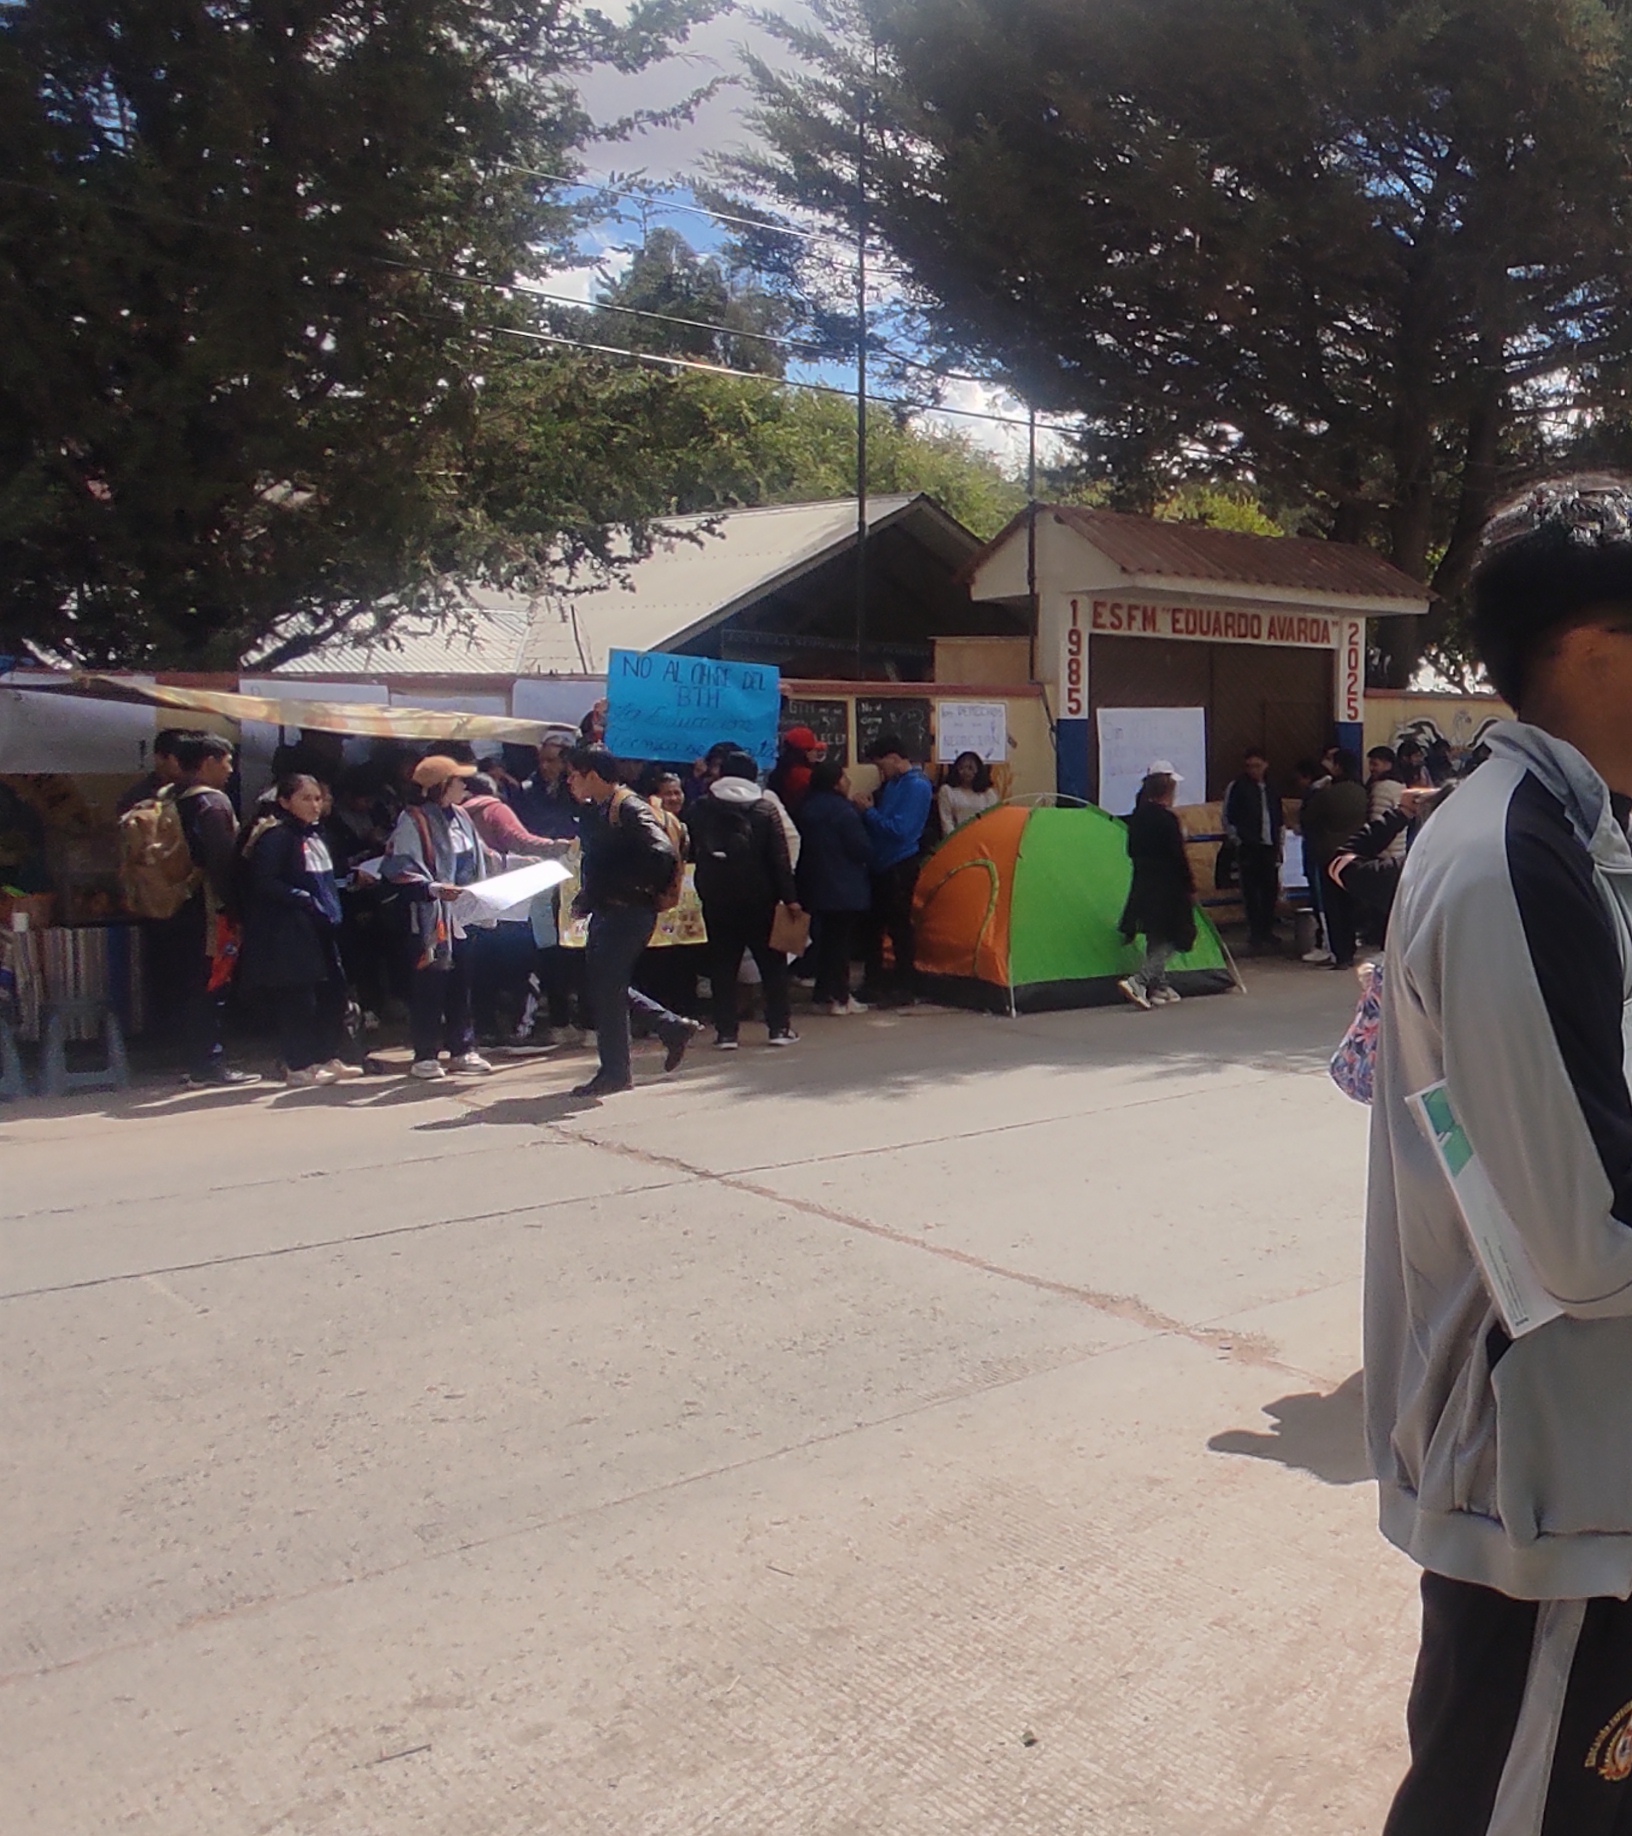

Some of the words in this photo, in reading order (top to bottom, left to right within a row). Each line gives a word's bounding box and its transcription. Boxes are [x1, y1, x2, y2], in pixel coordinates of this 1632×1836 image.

[622, 655, 652, 679] NO
[741, 670, 767, 692] DEL
[1066, 599, 1082, 716] 1985
[1346, 622, 1360, 721] 2025
[676, 685, 721, 709] BTH
